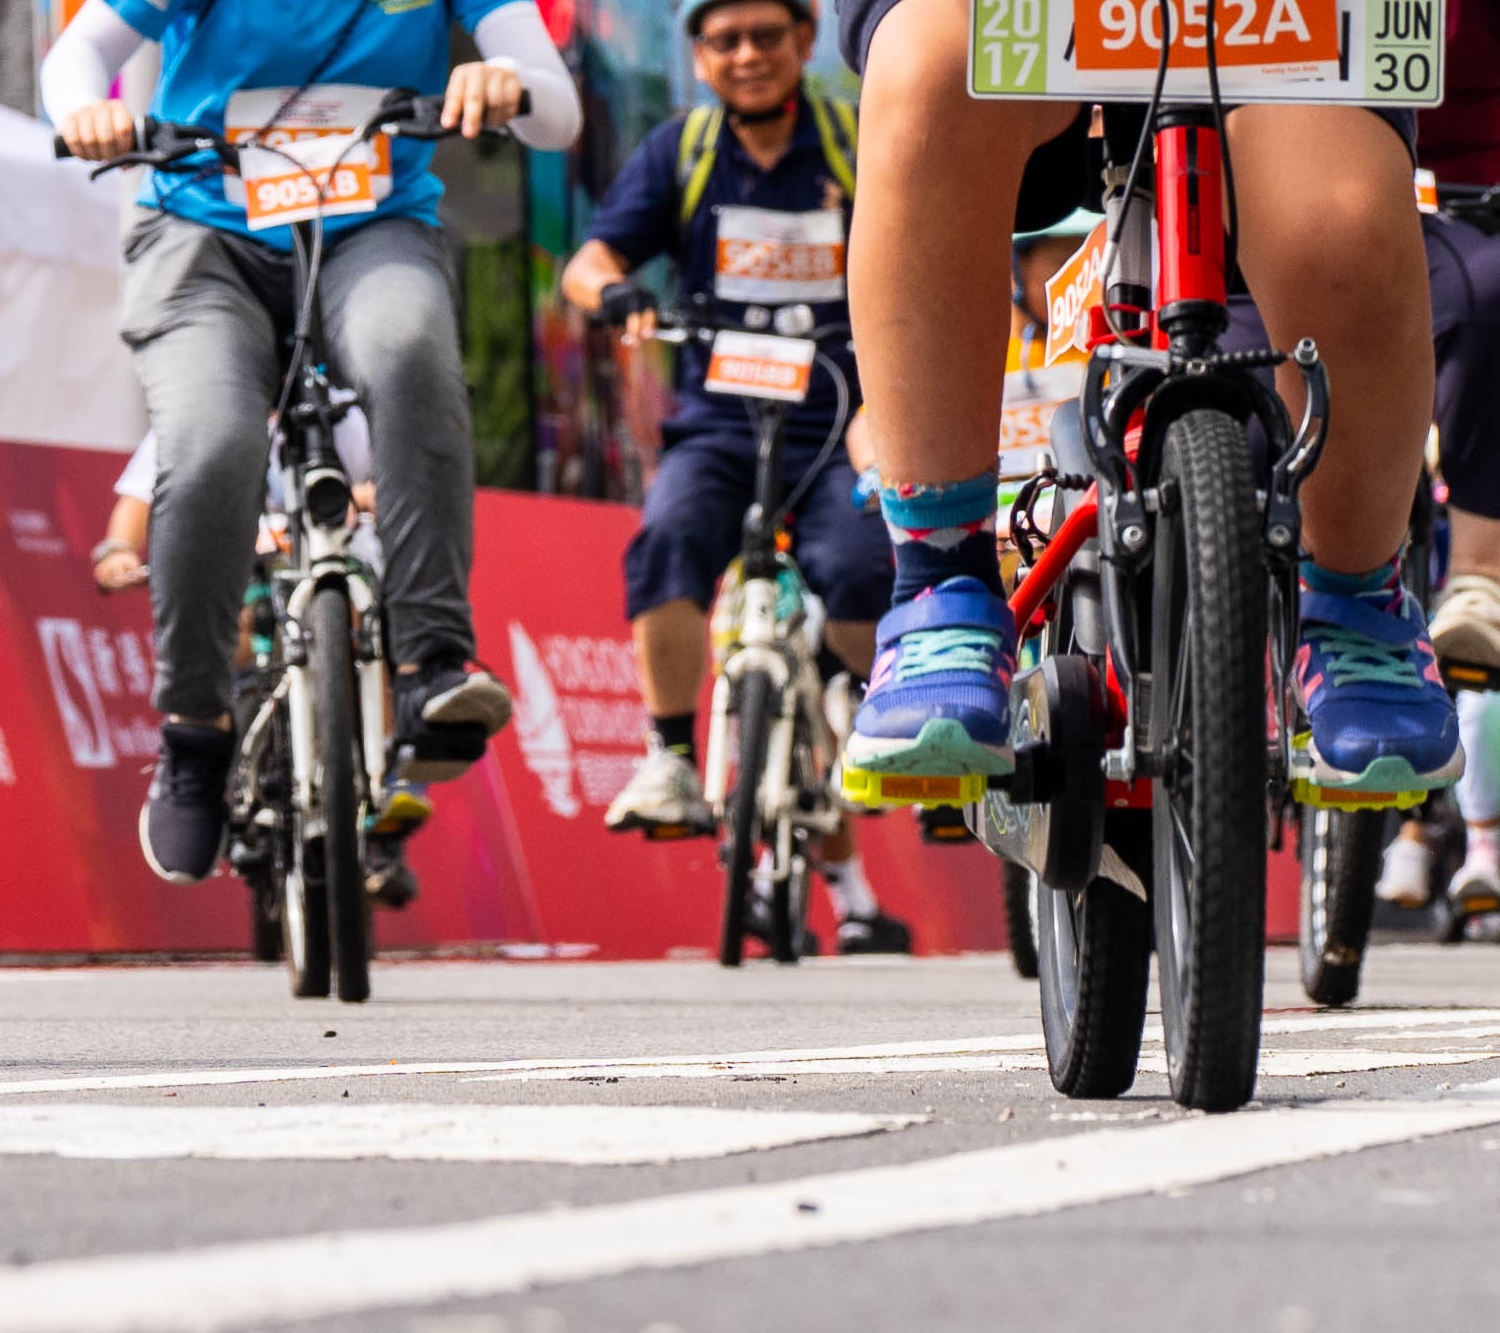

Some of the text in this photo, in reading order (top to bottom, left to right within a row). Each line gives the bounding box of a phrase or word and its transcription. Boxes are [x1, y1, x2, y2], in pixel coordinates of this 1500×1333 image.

[1375, 0, 1432, 40] JUN
[984, 42, 1039, 87] 17
[1374, 53, 1431, 92] 30
